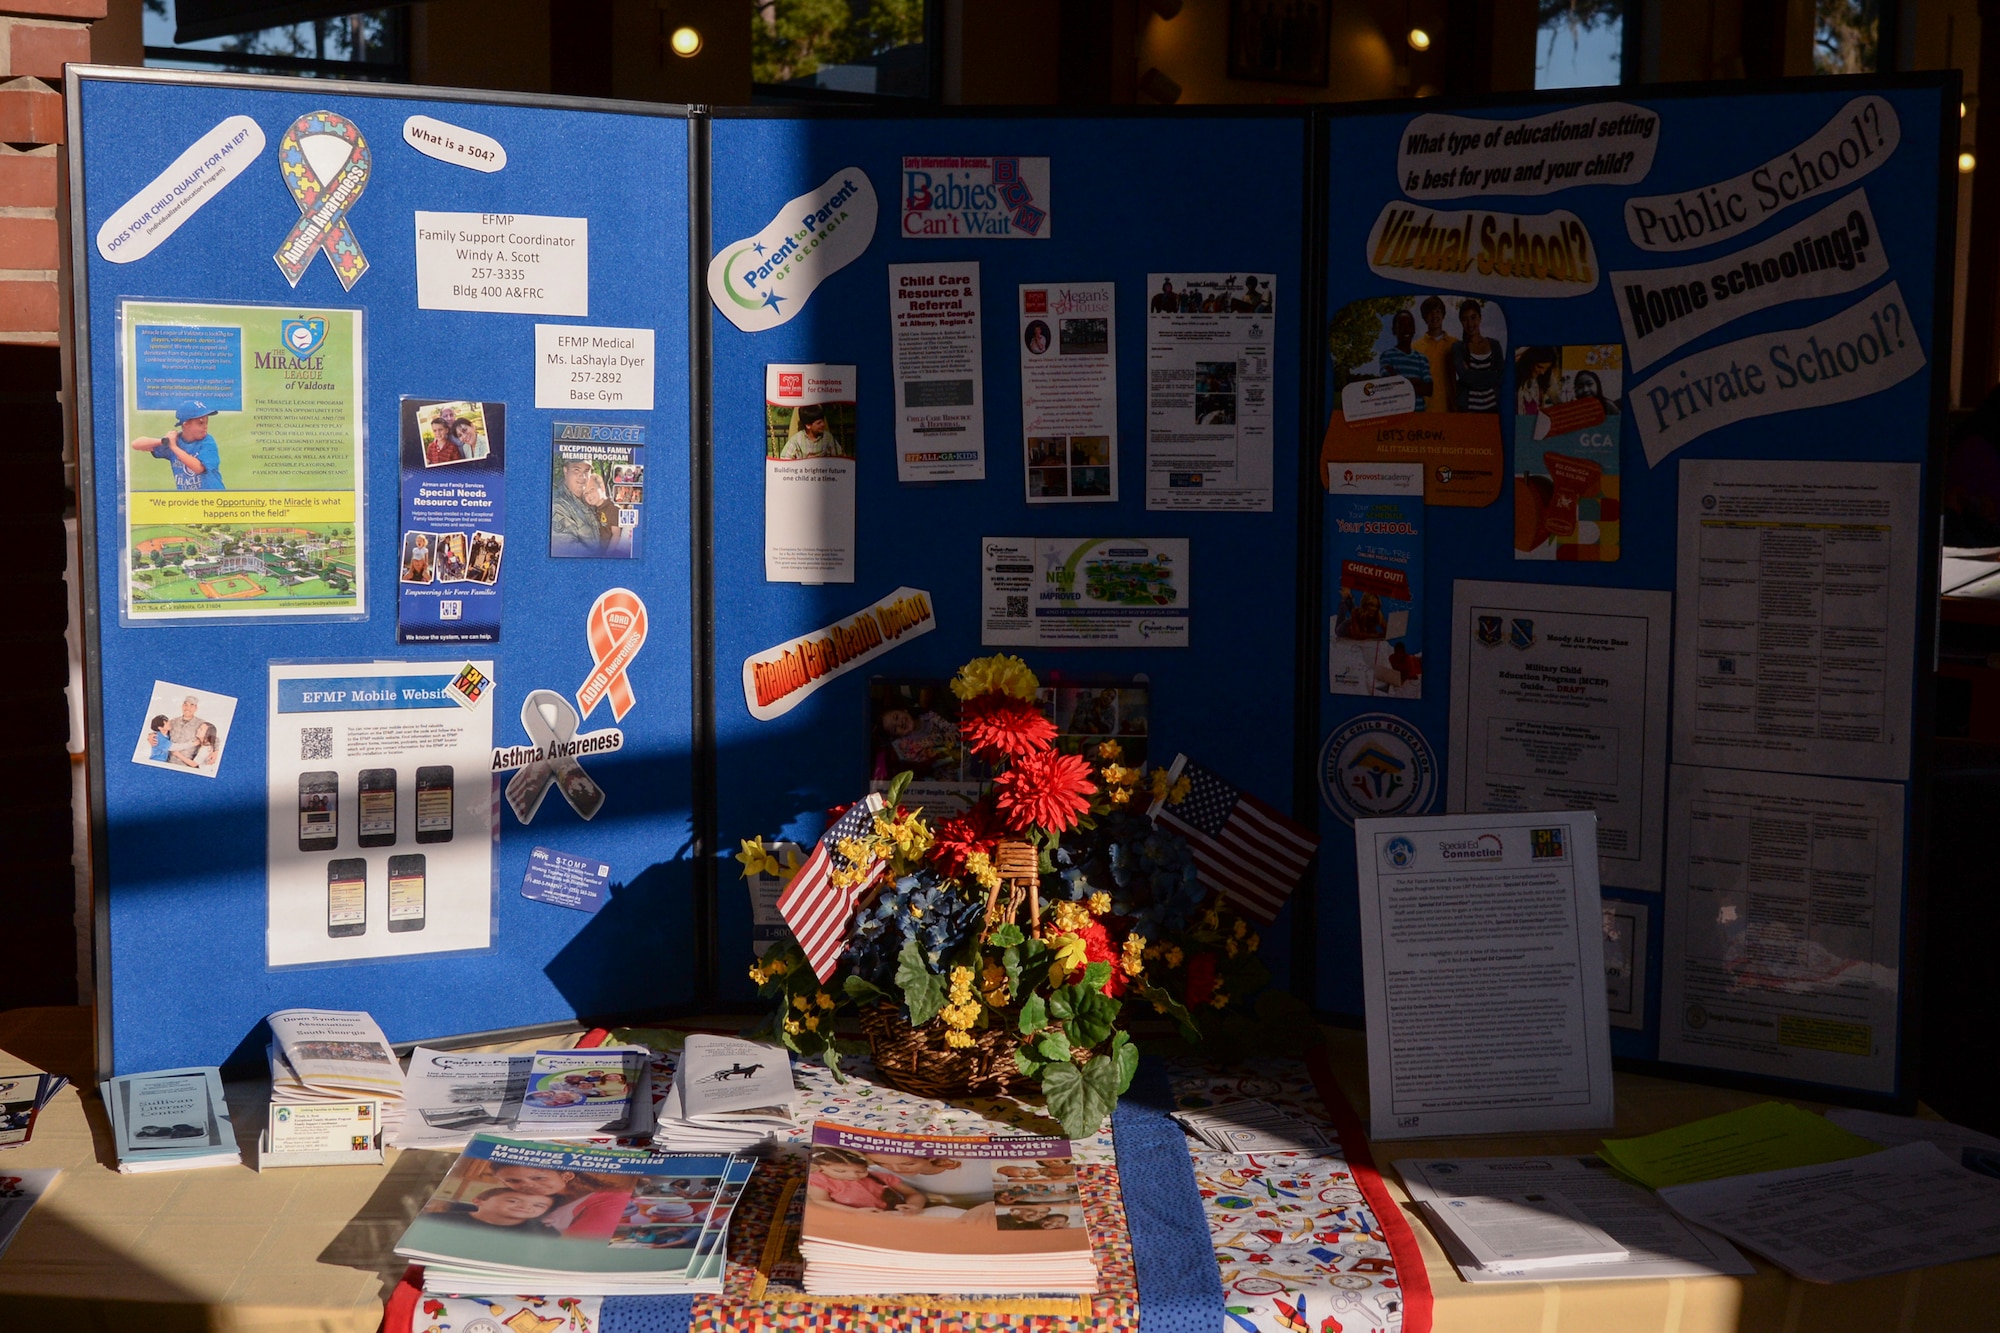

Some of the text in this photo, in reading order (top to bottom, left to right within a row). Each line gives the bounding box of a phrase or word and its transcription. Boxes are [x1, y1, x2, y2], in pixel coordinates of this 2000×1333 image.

[1407, 114, 1656, 156] What type of educational setting
[411, 126, 495, 163] What is a 504?
[1406, 152, 1634, 190] is best for you and your child?
[1632, 103, 1884, 245] Public School?
[108, 128, 250, 252] DOES YOUR CHILD QUALIFY FOR AN IEP?
[904, 171, 997, 211] Babies
[146, 166, 226, 235] (Individualized Education Program)
[284, 166, 365, 265] Autism Awareness
[482, 214, 515, 226] EFMP
[904, 212, 1011, 235] Can't Wait
[419, 229, 576, 247] Family Support Coordinator
[743, 179, 858, 289] Parent to Parent
[776, 211, 848, 280] OF GEORGIA
[1373, 209, 1592, 283] Virtual School?
[455, 249, 540, 263] Windy A. Scott
[471, 267, 525, 280] 257-3335
[1624, 209, 1870, 340] Home schooling?
[901, 275, 970, 287] Child Care
[452, 285, 544, 299] Bldg 400 A&FRC
[898, 287, 973, 299] Resource &
[1059, 288, 1109, 303] Megan's
[910, 299, 962, 310] Referral
[1068, 302, 1109, 313] House
[558, 336, 635, 349] EFMP Medical
[254, 352, 322, 371] MIRACLE
[547, 354, 645, 368] Ms. LaShayla Dyer
[1647, 360, 1766, 434] Private
[1769, 302, 1905, 390] School?
[284, 370, 323, 380] LEAGUE
[570, 372, 622, 384] 257-2892
[807, 378, 842, 386] Champions
[285, 380, 335, 391] of Valdosta
[570, 389, 623, 403] Base Gym
[1407, 429, 1446, 441] GROW.
[1579, 433, 1613, 447] GCA
[559, 444, 632, 455] EXCEPTIONAL FAMILY
[562, 452, 629, 462] MEMBER PROGRAM
[419, 488, 487, 499] Special Needs
[168, 498, 199, 508] provide
[200, 498, 214, 506] the
[216, 497, 267, 508] Opportunity,
[268, 497, 282, 506] the
[284, 497, 312, 506] Miracle
[313, 497, 320, 506] is
[321, 497, 341, 506] what
[413, 498, 493, 507] Resource Center
[1335, 518, 1418, 535] Your SCHOOL.
[1046, 571, 1075, 583] NEW
[1347, 562, 1404, 584] CHECK IT OUT!
[1040, 592, 1081, 600] IMPROVED
[1547, 634, 1572, 643] Moody
[1587, 637, 1608, 645] Force
[752, 592, 931, 707] Extended Care Health Option
[581, 631, 641, 706] ADHD Awareness
[1525, 663, 1582, 674] Military Child
[1499, 671, 1609, 687] Education Program (MCEP)
[302, 691, 348, 704] EFMP
[351, 689, 397, 702] Mobile
[493, 733, 620, 771] Asthma Awareness
[1328, 722, 1430, 783] MILITARY CHILD EDUCATION
[1439, 840, 1479, 851] Special Ed
[1442, 848, 1502, 859] Connection
[139, 1098, 193, 1107] Sullivan
[140, 1104, 195, 1112] Literacy
[141, 1109, 187, 1117] Center
[839, 1132, 1053, 1150] Helping Children with
[991, 1134, 1061, 1143] Handbook
[493, 1143, 665, 1165] Helping Your Child
[839, 1138, 1048, 1158] Learning Disabilities
[490, 1150, 622, 1170] Manage ADHD
